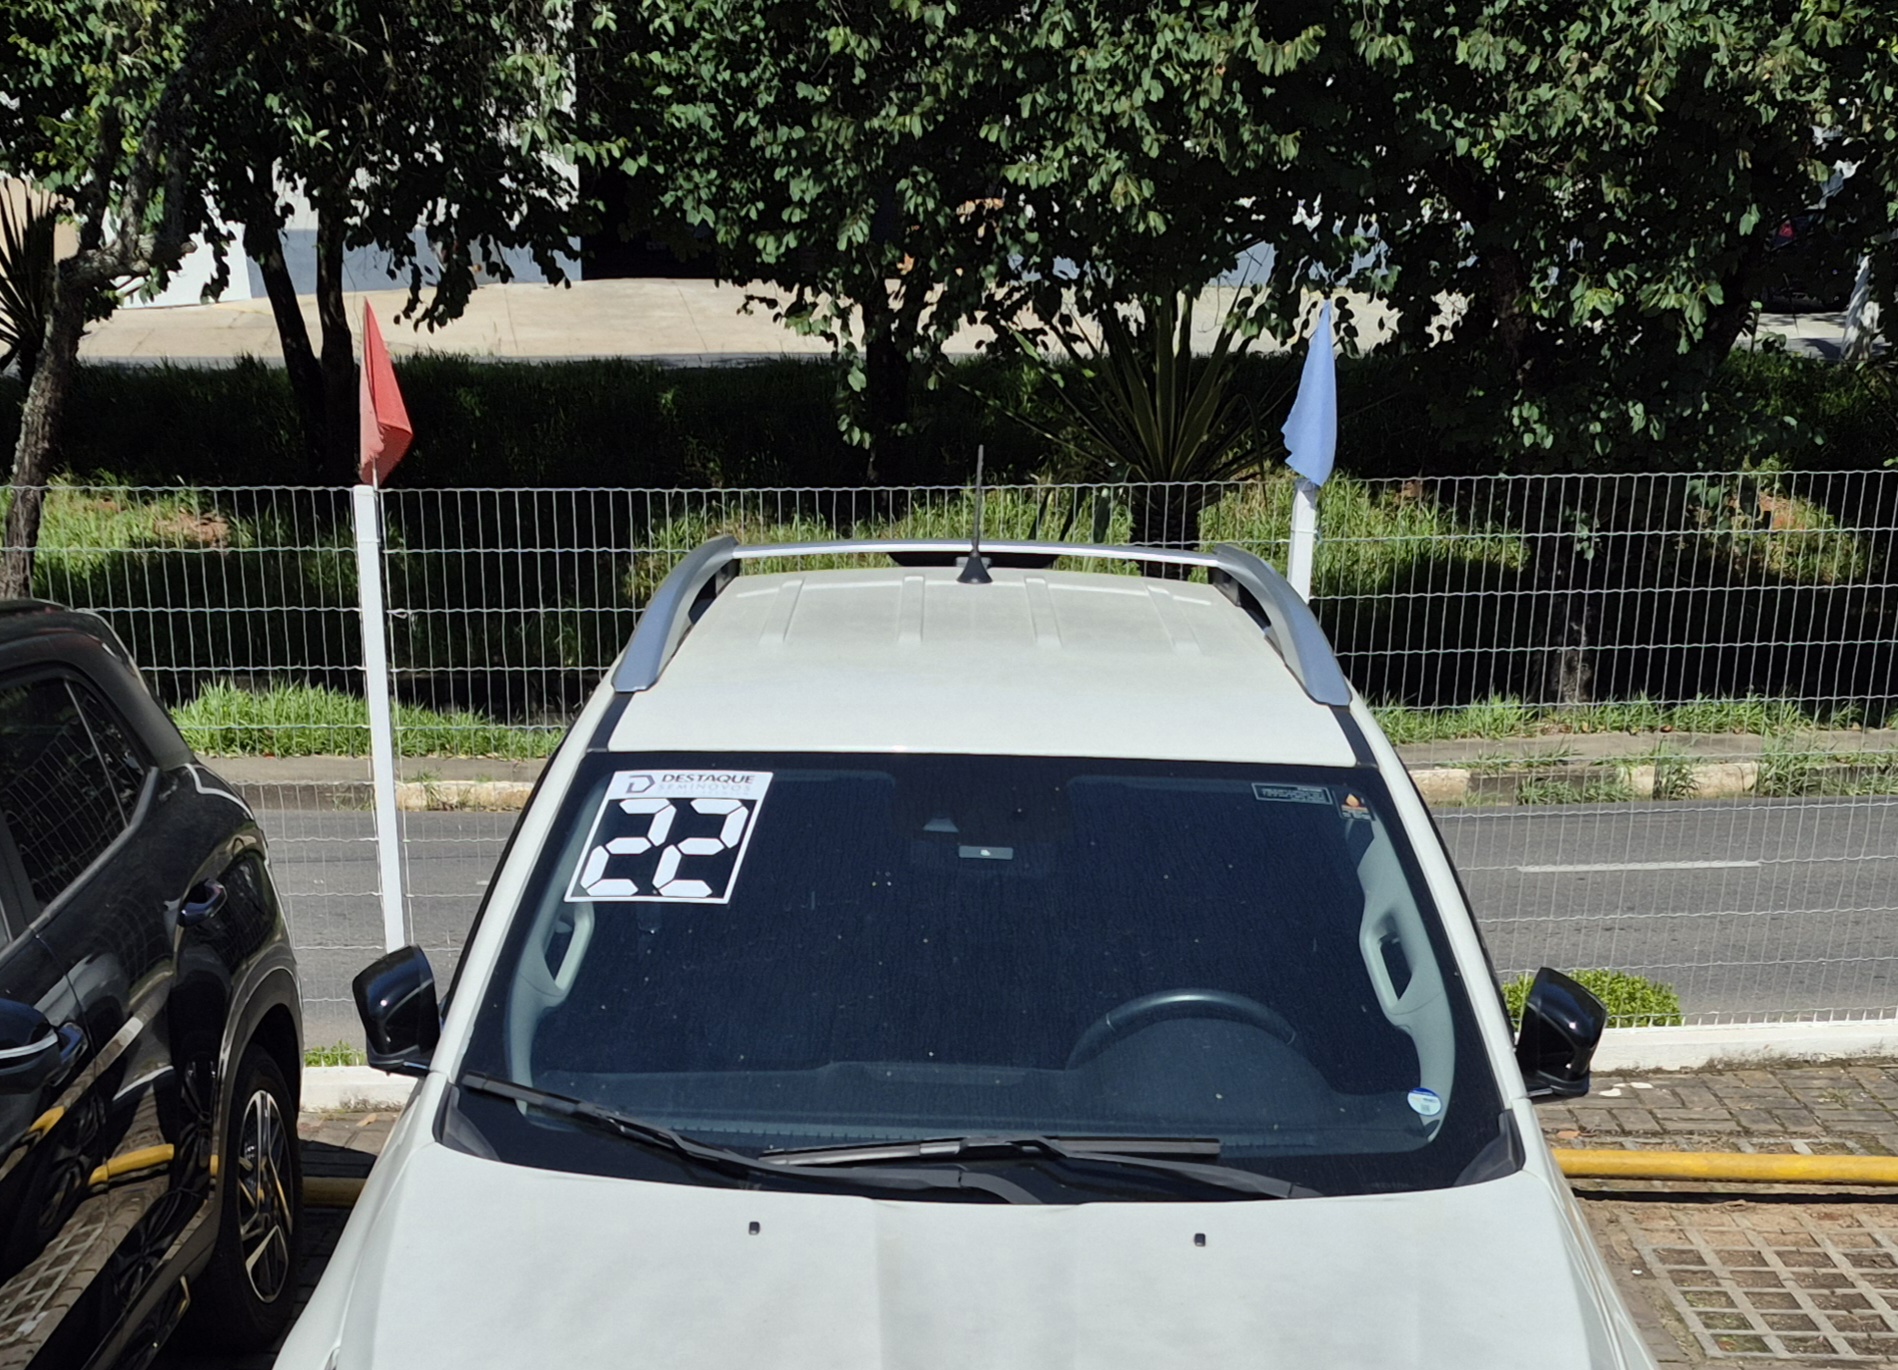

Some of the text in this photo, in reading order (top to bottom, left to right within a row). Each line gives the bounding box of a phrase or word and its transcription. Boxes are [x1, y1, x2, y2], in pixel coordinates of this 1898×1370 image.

[661, 773, 756, 784] DESTAQUE
[658, 783, 751, 792] SEMINOVOS
[580, 798, 749, 898] 22
